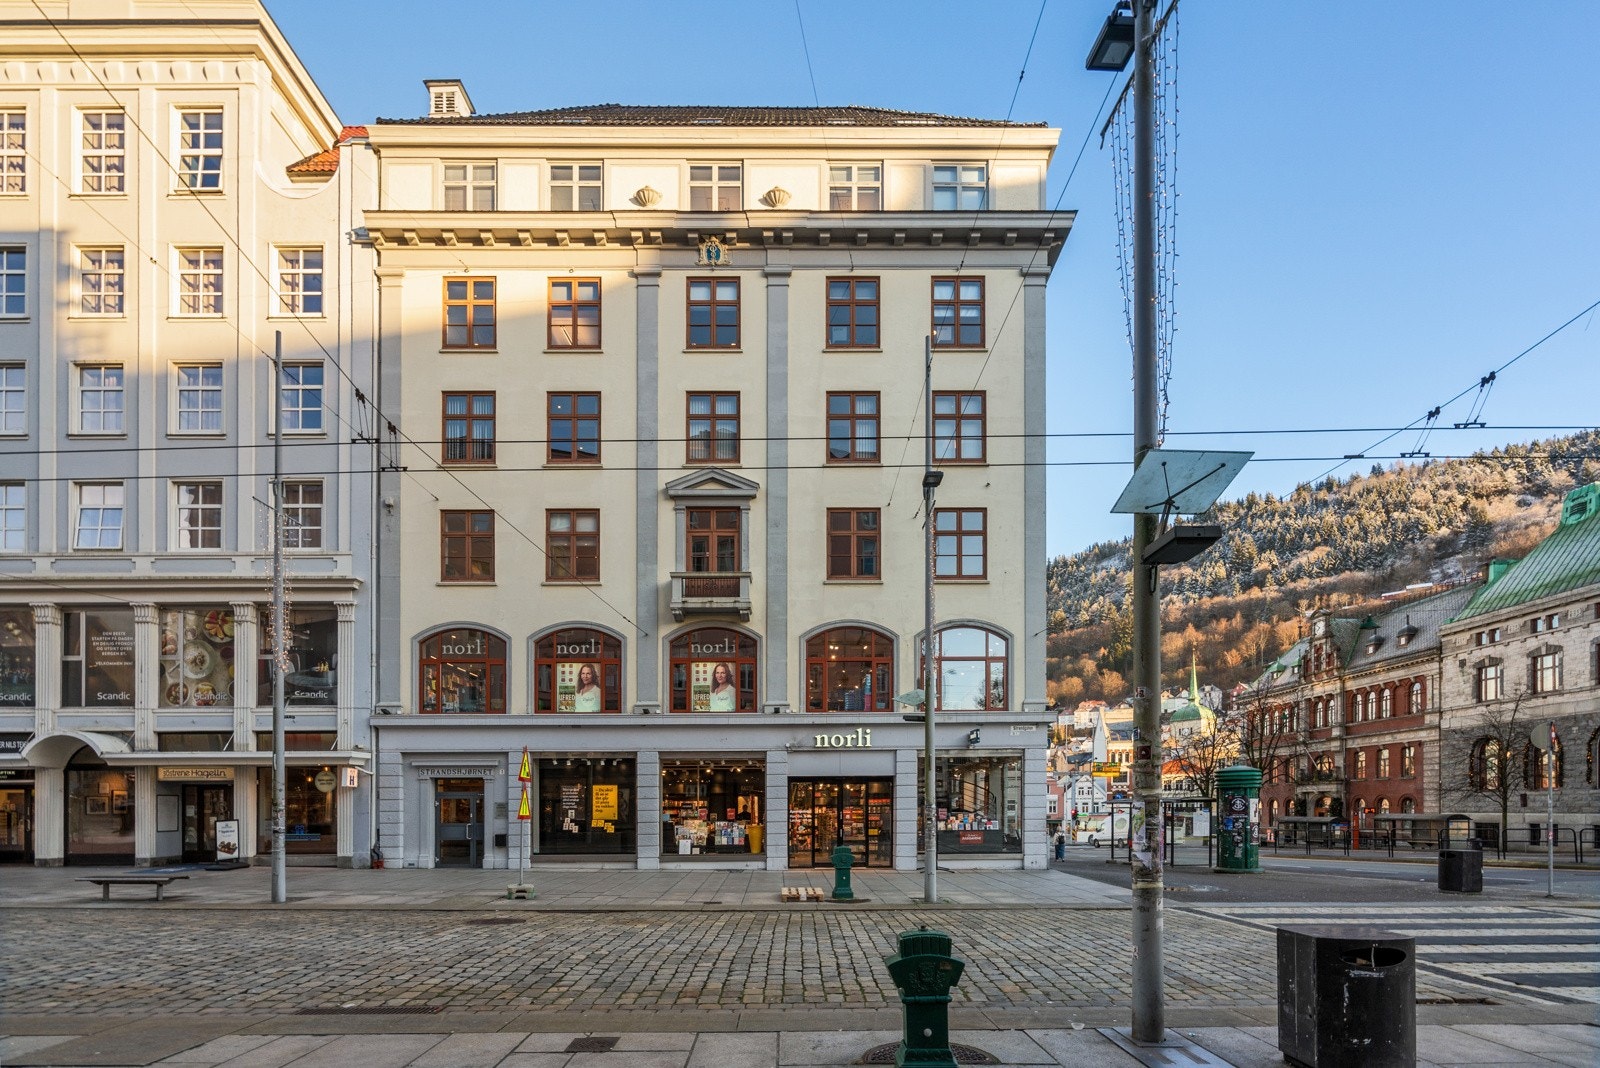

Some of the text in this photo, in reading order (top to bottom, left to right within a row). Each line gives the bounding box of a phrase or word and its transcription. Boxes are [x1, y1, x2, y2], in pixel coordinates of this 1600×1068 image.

[691, 638, 736, 653] norli
[97, 692, 131, 700] Scandic
[294, 690, 329, 699] Scandic
[814, 727, 872, 748] norli
[192, 769, 226, 778] Hagelin
[349, 775, 355, 785] H
